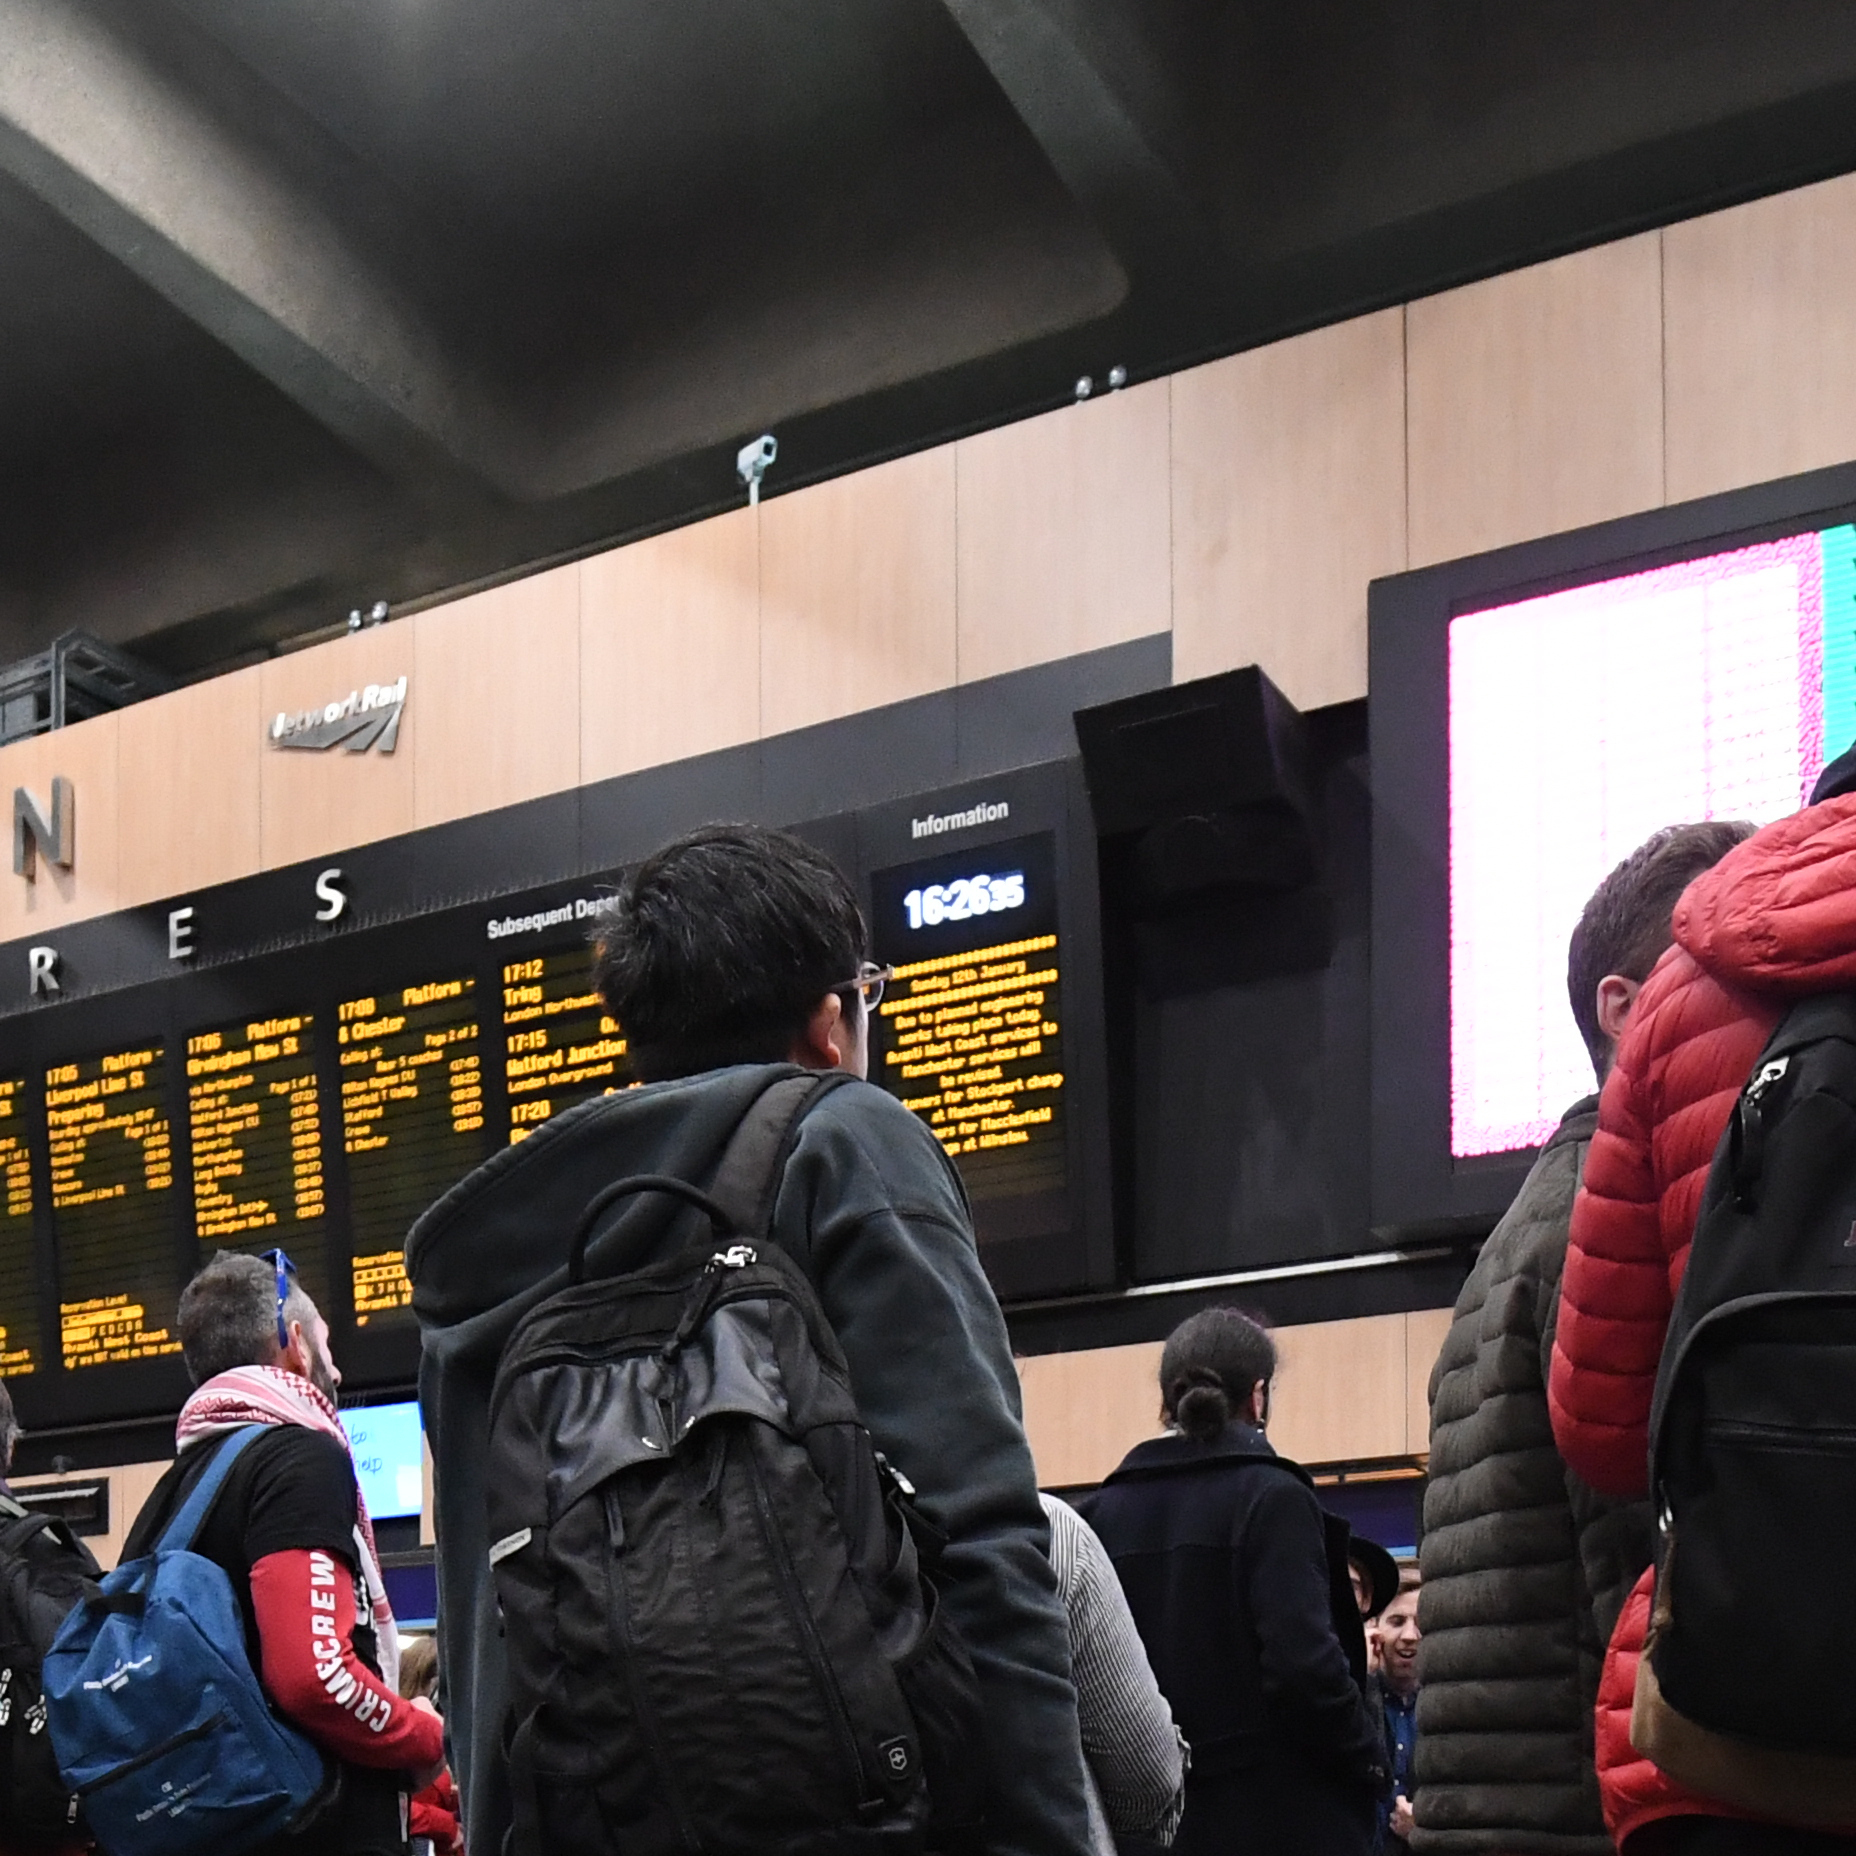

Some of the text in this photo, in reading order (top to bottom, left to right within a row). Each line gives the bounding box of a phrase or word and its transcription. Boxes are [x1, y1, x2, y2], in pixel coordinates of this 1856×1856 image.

[362, 676, 407, 712] Rail
[912, 801, 1009, 839] Information
[487, 894, 621, 940] Subsequent Depar
[503, 958, 543, 984] 17:12
[910, 976, 950, 993] Sunday
[980, 960, 1026, 979] January
[403, 981, 462, 1007] Platform
[504, 985, 543, 1007] Tring
[504, 1005, 543, 1024] London
[895, 990, 1044, 1030] Due to planned engineering
[246, 1016, 301, 1041] Platform
[351, 1015, 406, 1041] Chester
[507, 1028, 547, 1053] 17:15
[898, 1029, 932, 1045] works
[935, 1022, 971, 1039] taking
[972, 1014, 1004, 1034] place
[954, 1034, 988, 1052] Coast
[990, 1025, 1040, 1045] services
[1042, 1021, 1058, 1035] to
[102, 1050, 153, 1073] Platform
[506, 1039, 628, 1077] Watford Junction
[902, 1040, 1042, 1079] Manchester services will
[508, 1061, 614, 1094] London Overground
[944, 1090, 964, 1104] for
[966, 1077, 1025, 1100] Stockport
[46, 1080, 99, 1107] Liverpool
[48, 1102, 105, 1126] Preparing
[511, 1099, 551, 1124] 17:20
[931, 1108, 946, 1124] at
[980, 1106, 1052, 1131] Macclesfield
[350, 1423, 367, 1446] to
